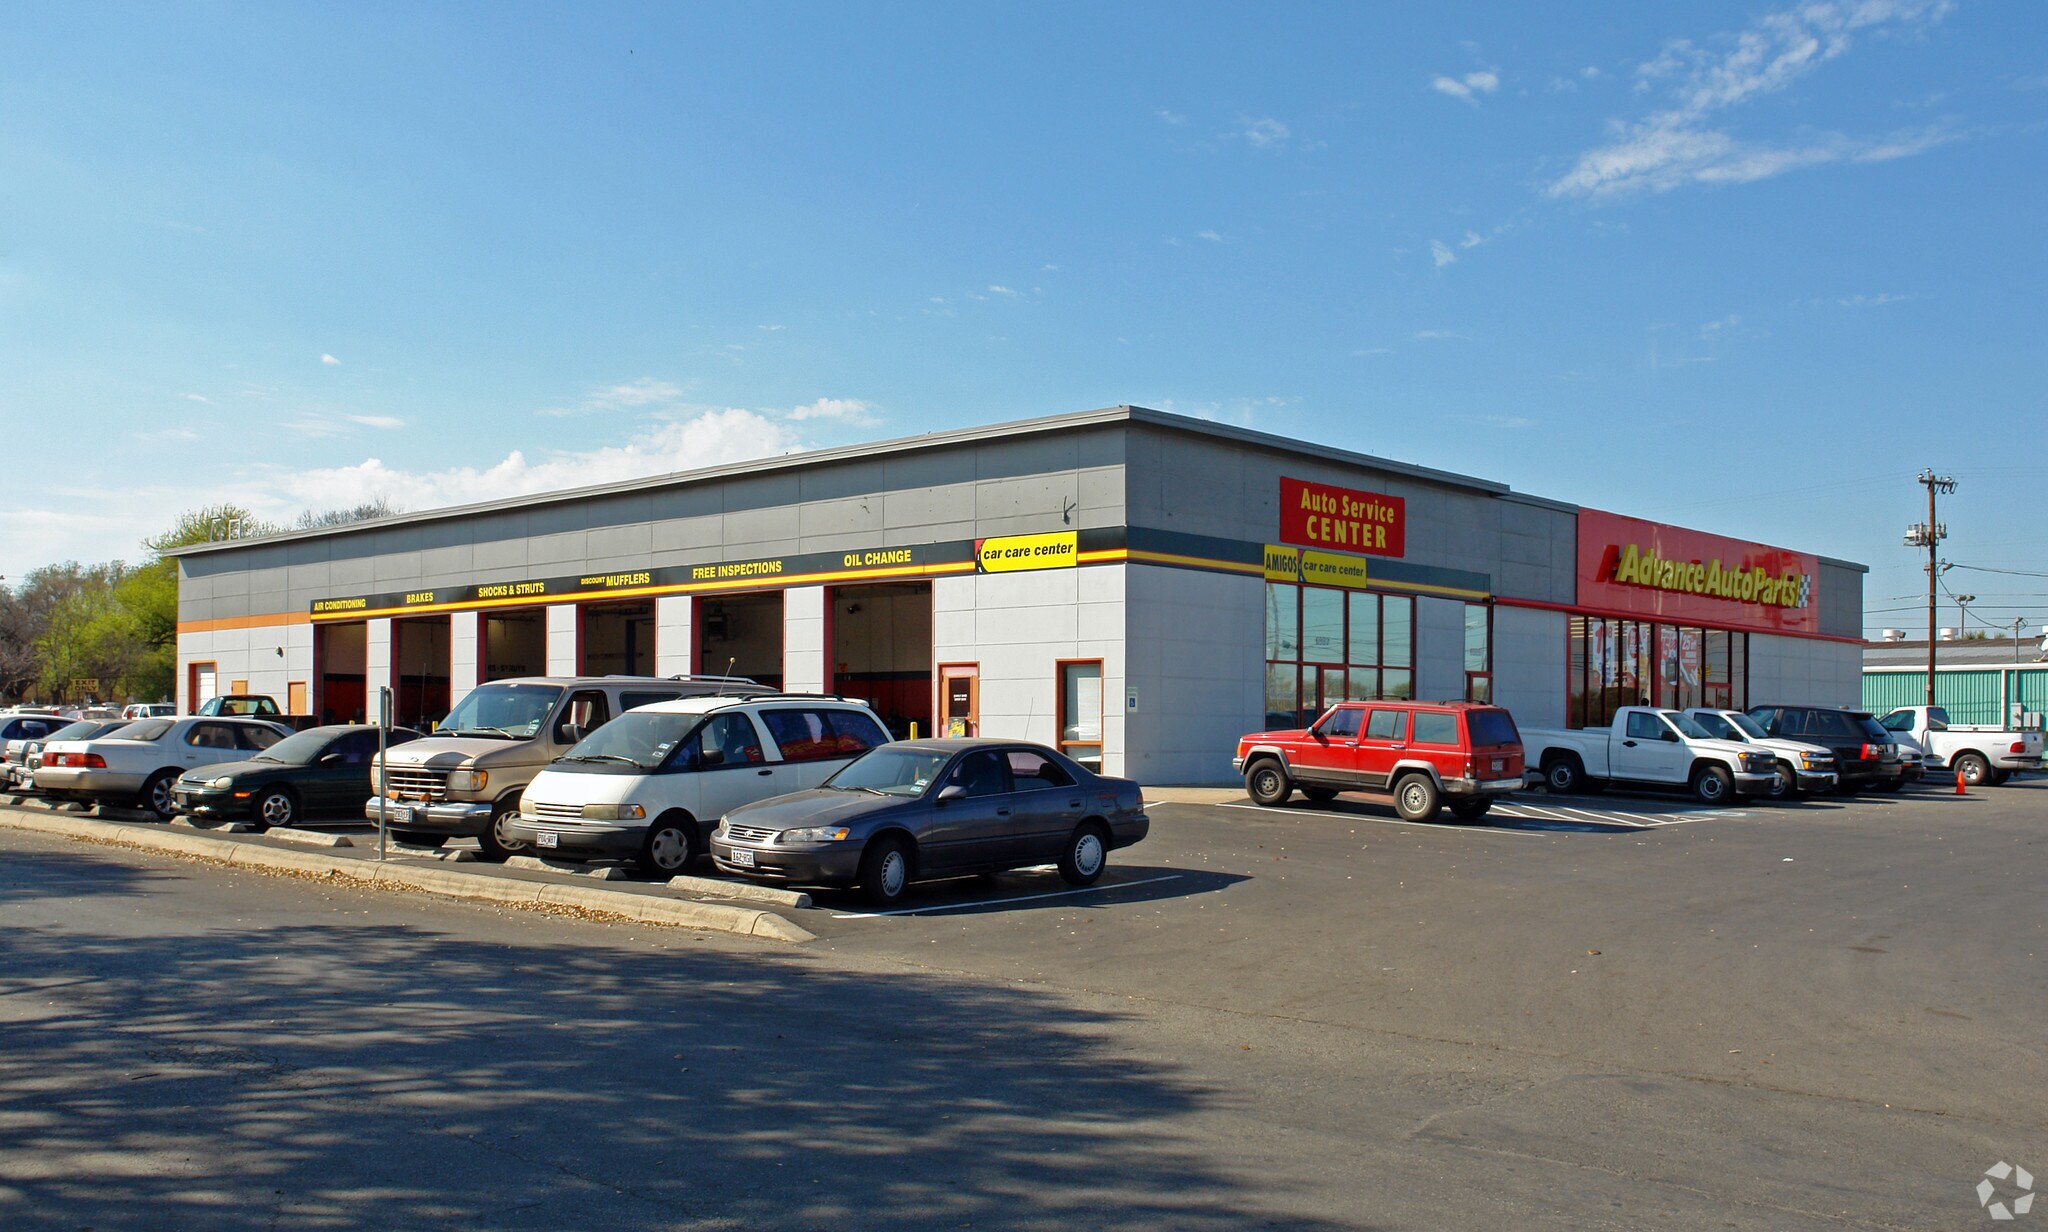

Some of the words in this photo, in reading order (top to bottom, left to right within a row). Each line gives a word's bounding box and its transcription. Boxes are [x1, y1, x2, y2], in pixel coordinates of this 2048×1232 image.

[1301, 488, 1337, 515] Auto
[1342, 495, 1394, 524] Service
[1306, 515, 1387, 549] CENTER
[844, 553, 862, 567] OIL
[864, 549, 911, 565] CHANGE
[983, 548, 1003, 561] car
[1005, 546, 1031, 559] care
[1034, 542, 1073, 556] center
[692, 567, 716, 580] FREE
[718, 560, 783, 577] INSPECTIONS
[1265, 553, 1298, 574] AMIGOS
[1304, 561, 1318, 571] car
[1319, 563, 1337, 574] care
[1339, 565, 1364, 577] center
[581, 576, 606, 585] DISCOUNT
[606, 572, 651, 587] MUFFLERS
[406, 592, 434, 604] BRAKES
[478, 585, 508, 598] SHOCKS
[509, 585, 515, 595] &
[516, 582, 545, 595] STRUTS
[314, 601, 324, 611] AIR
[325, 599, 366, 611] CONDITIONING
